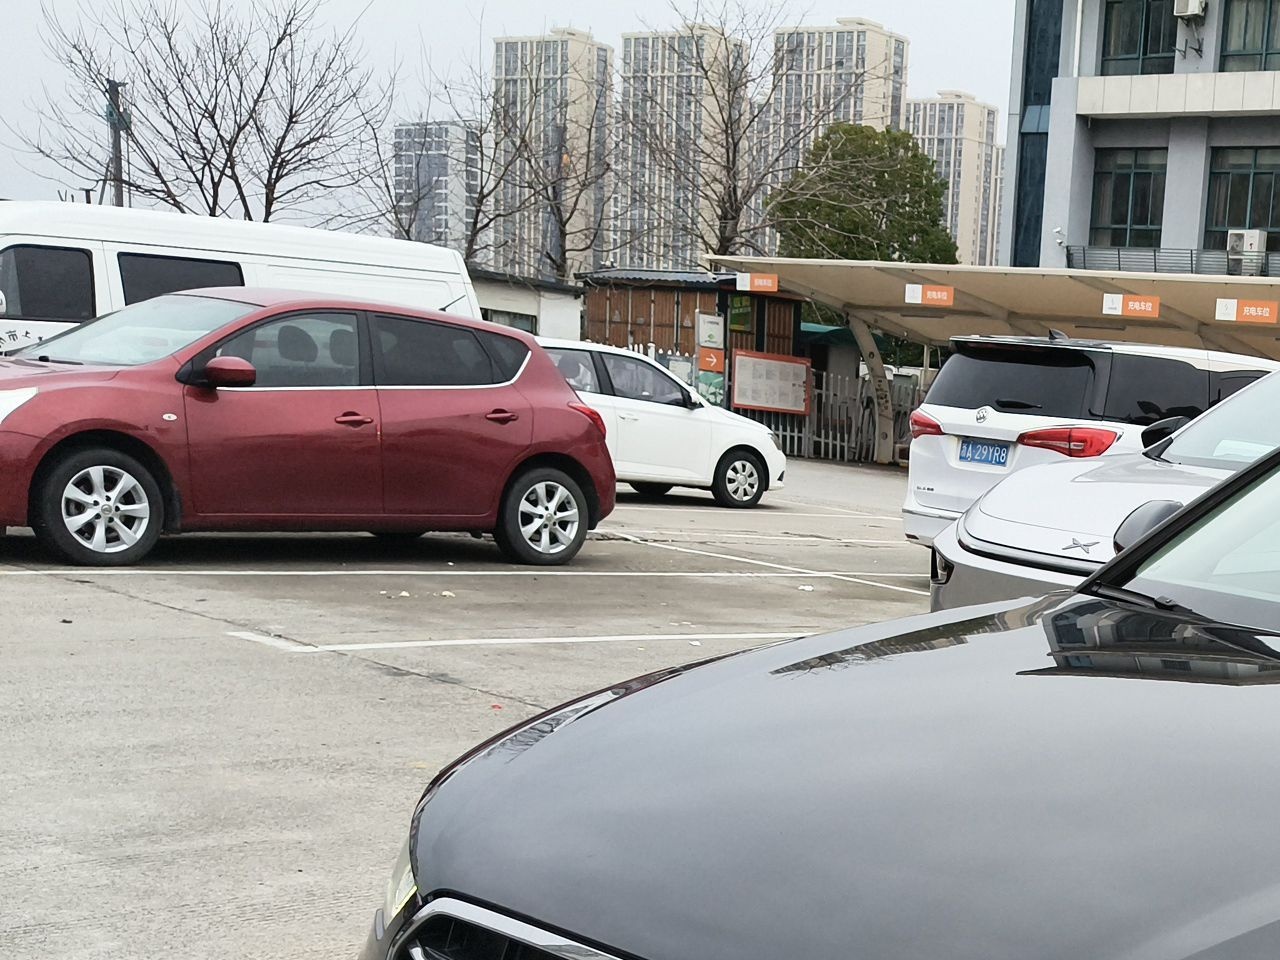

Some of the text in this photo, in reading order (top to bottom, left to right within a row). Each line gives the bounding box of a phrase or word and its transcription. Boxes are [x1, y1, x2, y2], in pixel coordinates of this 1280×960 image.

[1127, 301, 1153, 312] 充电车位
[1243, 306, 1270, 317] 充电车位
